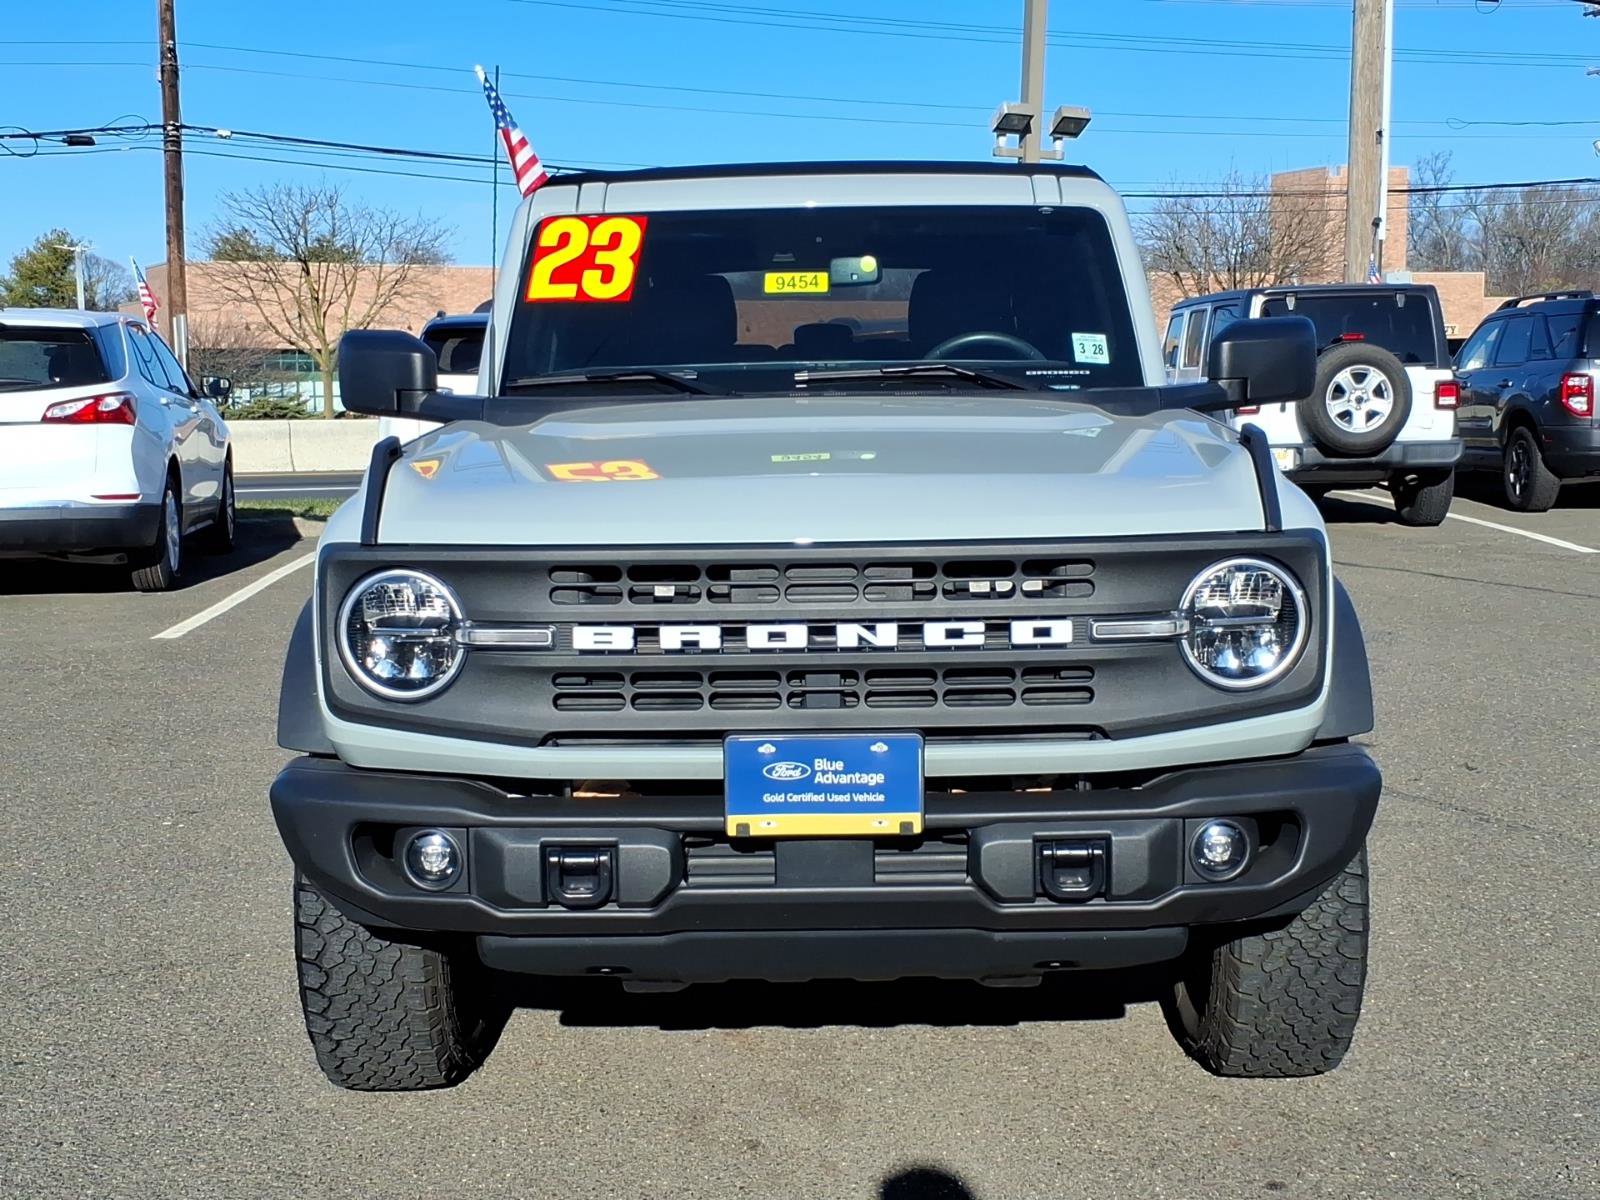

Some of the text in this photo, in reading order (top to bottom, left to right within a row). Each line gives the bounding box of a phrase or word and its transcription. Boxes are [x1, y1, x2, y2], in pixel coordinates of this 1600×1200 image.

[527, 216, 642, 299] 23
[775, 274, 820, 291] 9454
[1078, 342, 1104, 355] 3 28
[572, 620, 1073, 650] BRONCO
[772, 763, 803, 778] Ford
[814, 758, 844, 771] Blue
[814, 771, 885, 786] Advantage
[762, 791, 886, 803] Gold Certified Used Vehicle
